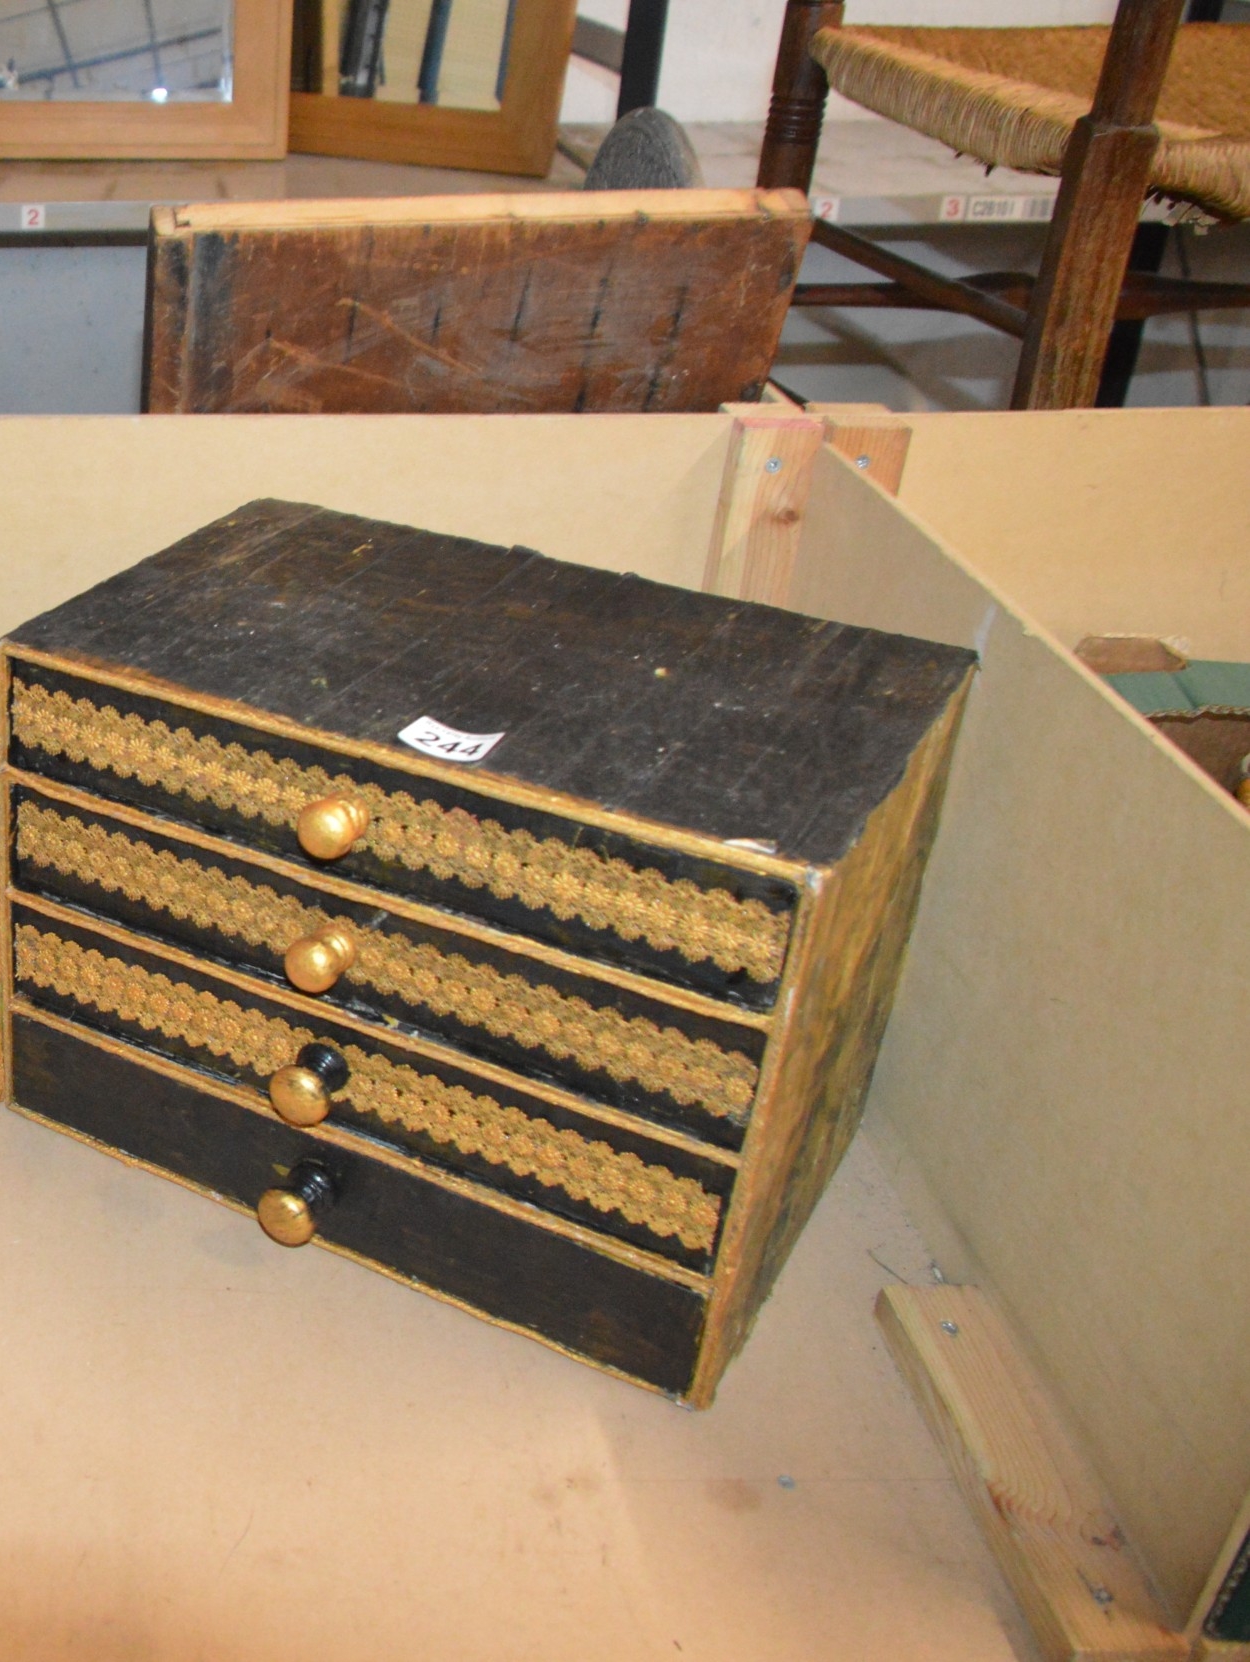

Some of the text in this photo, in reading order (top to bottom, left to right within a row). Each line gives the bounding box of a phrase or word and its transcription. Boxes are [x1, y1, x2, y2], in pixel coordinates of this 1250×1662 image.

[27, 208, 41, 226] 2
[821, 200, 834, 219] 2
[945, 199, 960, 217] 3
[414, 731, 484, 756] 244
